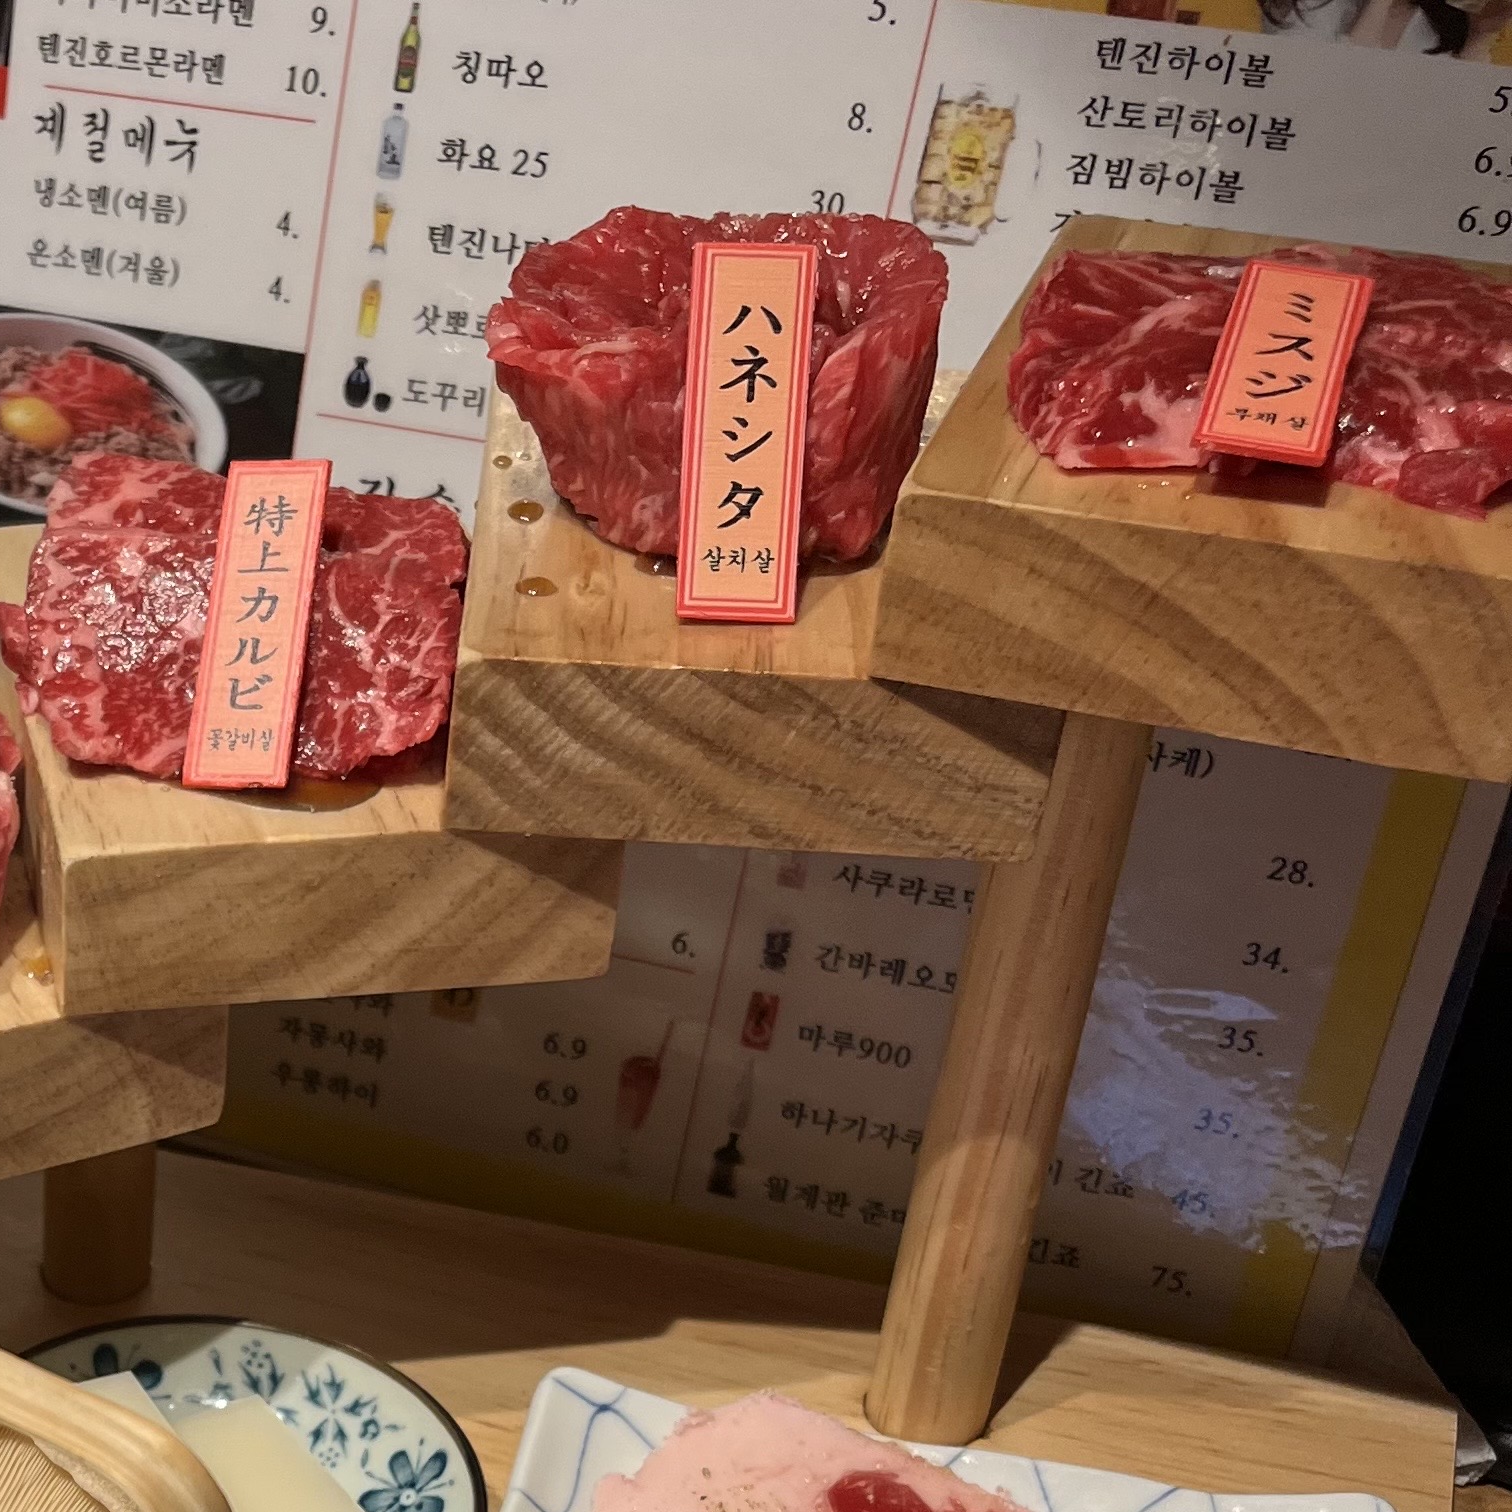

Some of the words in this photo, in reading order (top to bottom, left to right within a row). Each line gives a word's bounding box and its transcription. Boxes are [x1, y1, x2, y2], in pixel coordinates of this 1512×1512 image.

[310, 6, 336, 36] 9.
[37, 33, 226, 86] 텐진호르몬라멘
[284, 65, 328, 98] 10.
[1096, 37, 1274, 89] 텐진하이볼
[848, 102, 873, 133] 8.
[1076, 95, 1296, 151] 산토리하이볼
[1474, 146, 1512, 178] 6.
[437, 138, 501, 172] 화요
[510, 149, 551, 179] 25
[33, 177, 188, 227] 냉소멘(여름)
[275, 210, 300, 240] 4.
[1065, 152, 1244, 204] 짐빔하이볼
[1457, 205, 1512, 237] 6.9
[428, 223, 550, 265] 텐진나
[26, 238, 181, 288] 온소멘(겨울)
[267, 276, 292, 304] 4.
[1245, 291, 1316, 399] ミスジ
[401, 379, 487, 418] 도꾸리
[716, 304, 783, 530] ハネシタ
[700, 545, 776, 574] 살치살
[224, 495, 299, 711] 特上カルビ
[1266, 855, 1315, 888] 28.
[1241, 942, 1290, 975] 34.
[543, 1032, 587, 1060] 6.9
[799, 1025, 912, 1069] 마루900
[1218, 1026, 1265, 1058] 35.
[1193, 1107, 1240, 1139] 35.
[1150, 1265, 1193, 1297] 75.
